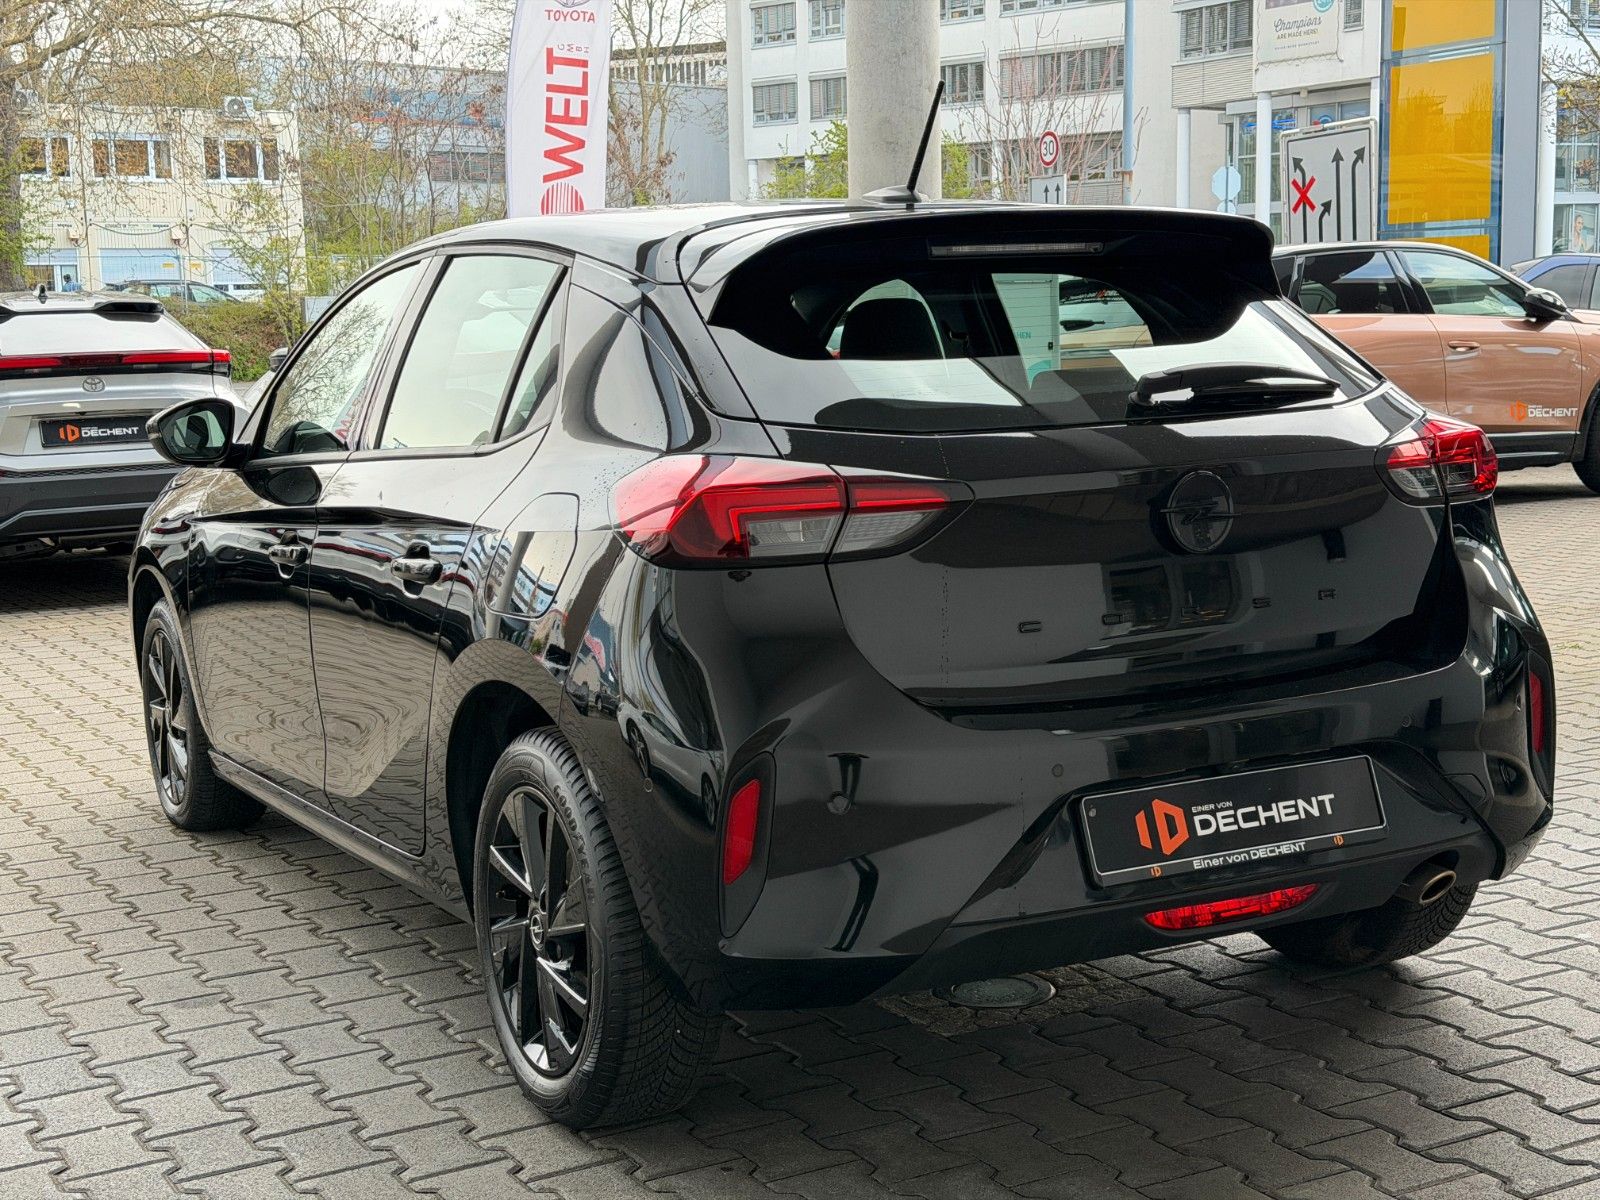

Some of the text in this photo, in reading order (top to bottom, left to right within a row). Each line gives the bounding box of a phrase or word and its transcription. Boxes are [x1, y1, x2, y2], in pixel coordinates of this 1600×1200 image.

[544, 9, 595, 23] TOYOTA
[1273, 16, 1322, 33] Champions
[542, 47, 589, 183] WELT
[1043, 140, 1054, 156] 30
[1528, 408, 1578, 417] DECHENT
[81, 427, 139, 437] DECHENT
[1191, 800, 1233, 813] EINER VON
[1193, 793, 1335, 837] DECHENT
[1193, 842, 1306, 870] Einer von DECHENT
